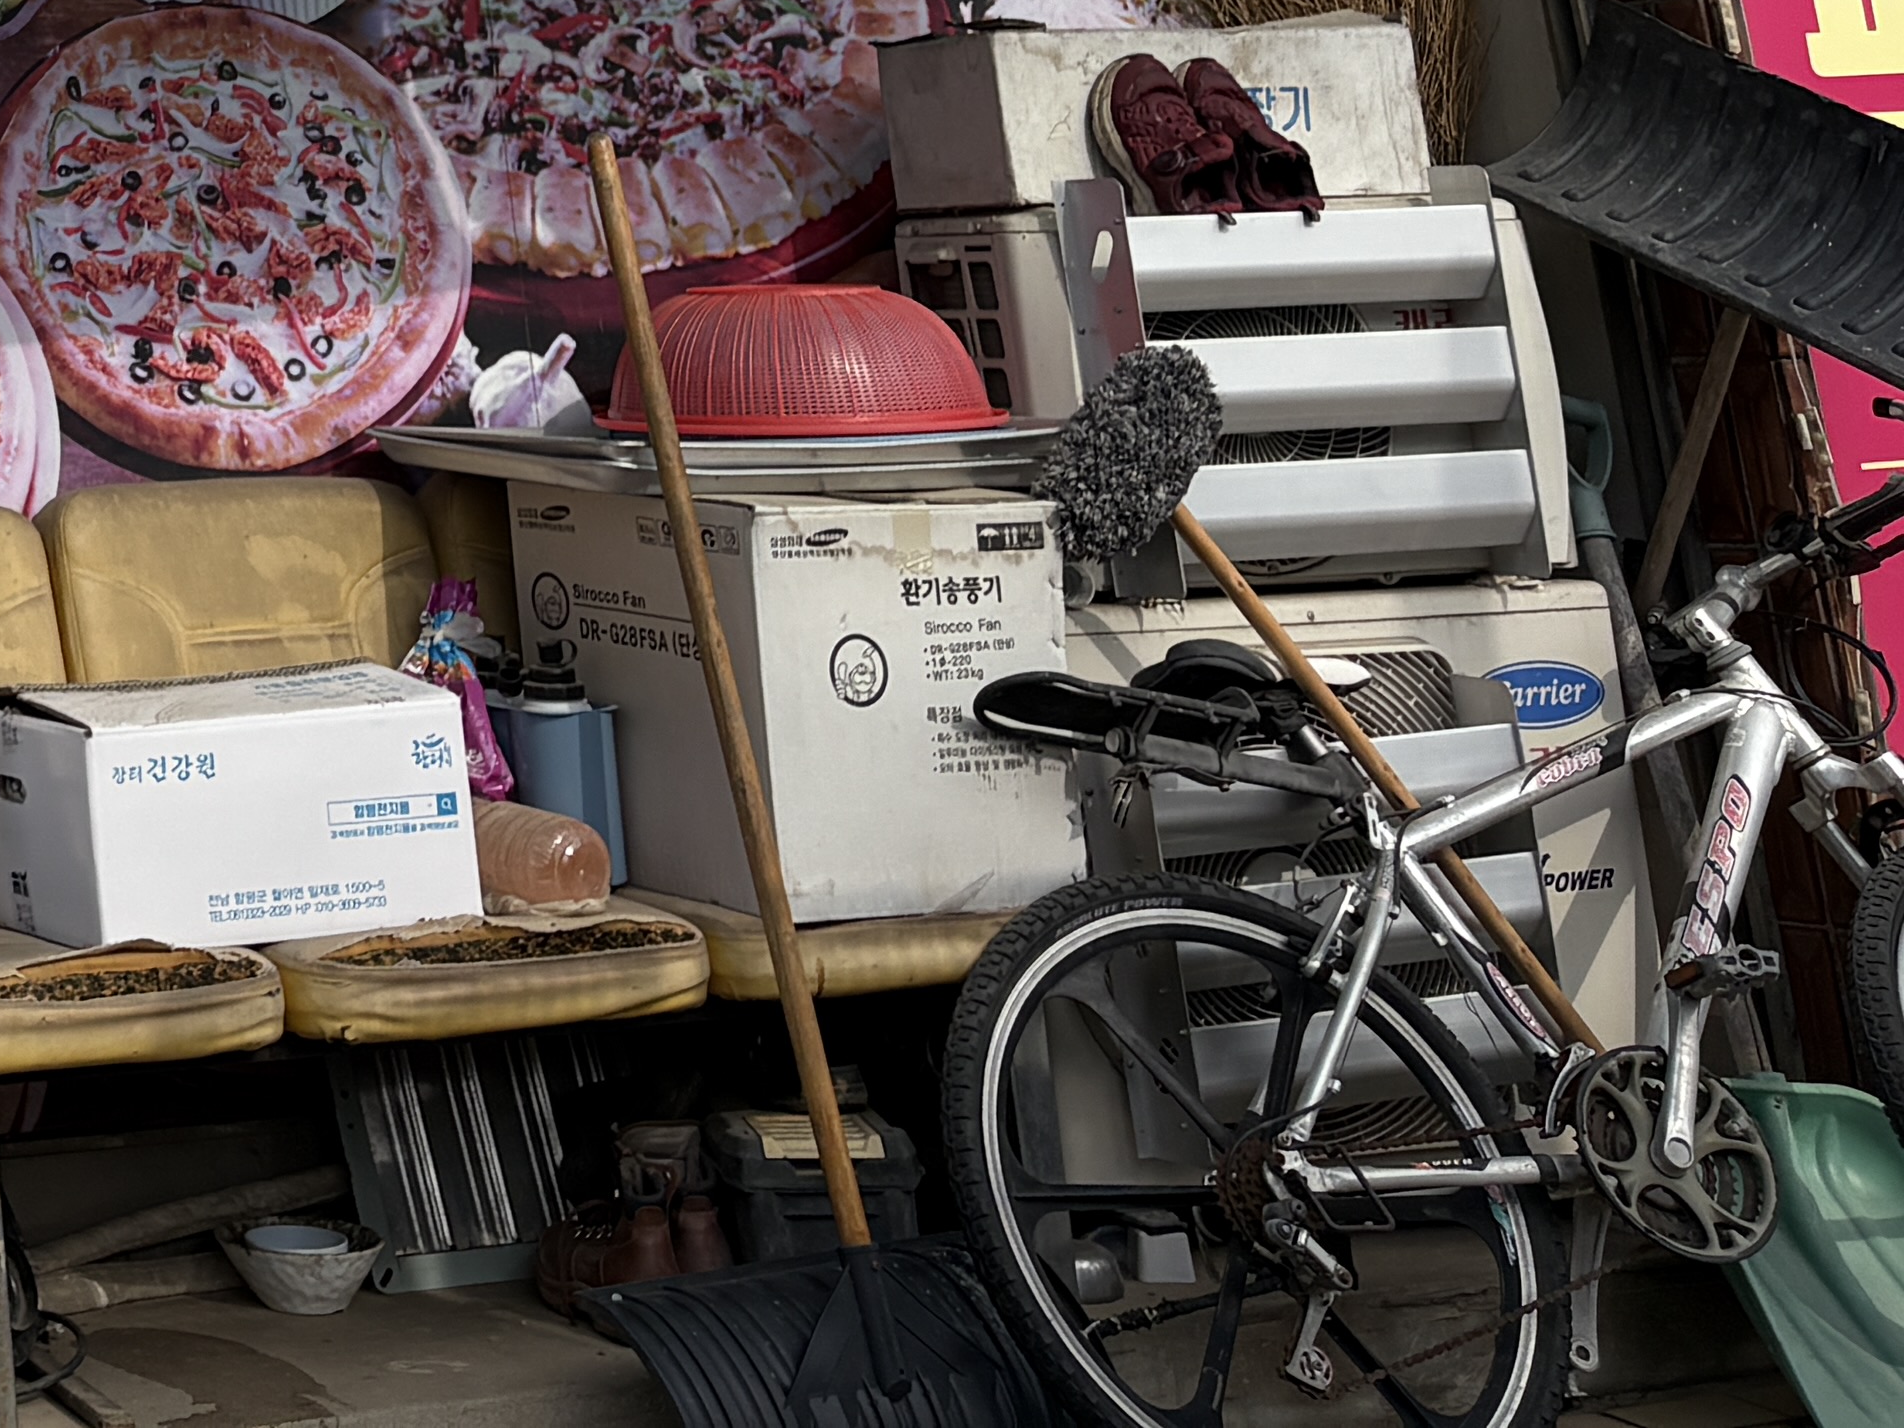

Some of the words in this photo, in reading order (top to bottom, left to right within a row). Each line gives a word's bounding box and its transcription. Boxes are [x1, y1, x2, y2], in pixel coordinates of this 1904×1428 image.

[572, 583, 620, 605] Sirocco
[622, 591, 646, 609] Fan
[900, 575, 1002, 607] 환기송풍기
[579, 617, 669, 653] DR-G28FSA
[924, 620, 973, 635] Sirocco
[978, 618, 1002, 632] Fan
[147, 752, 217, 783] 건강원
[1124, 896, 1183, 911] POWER
